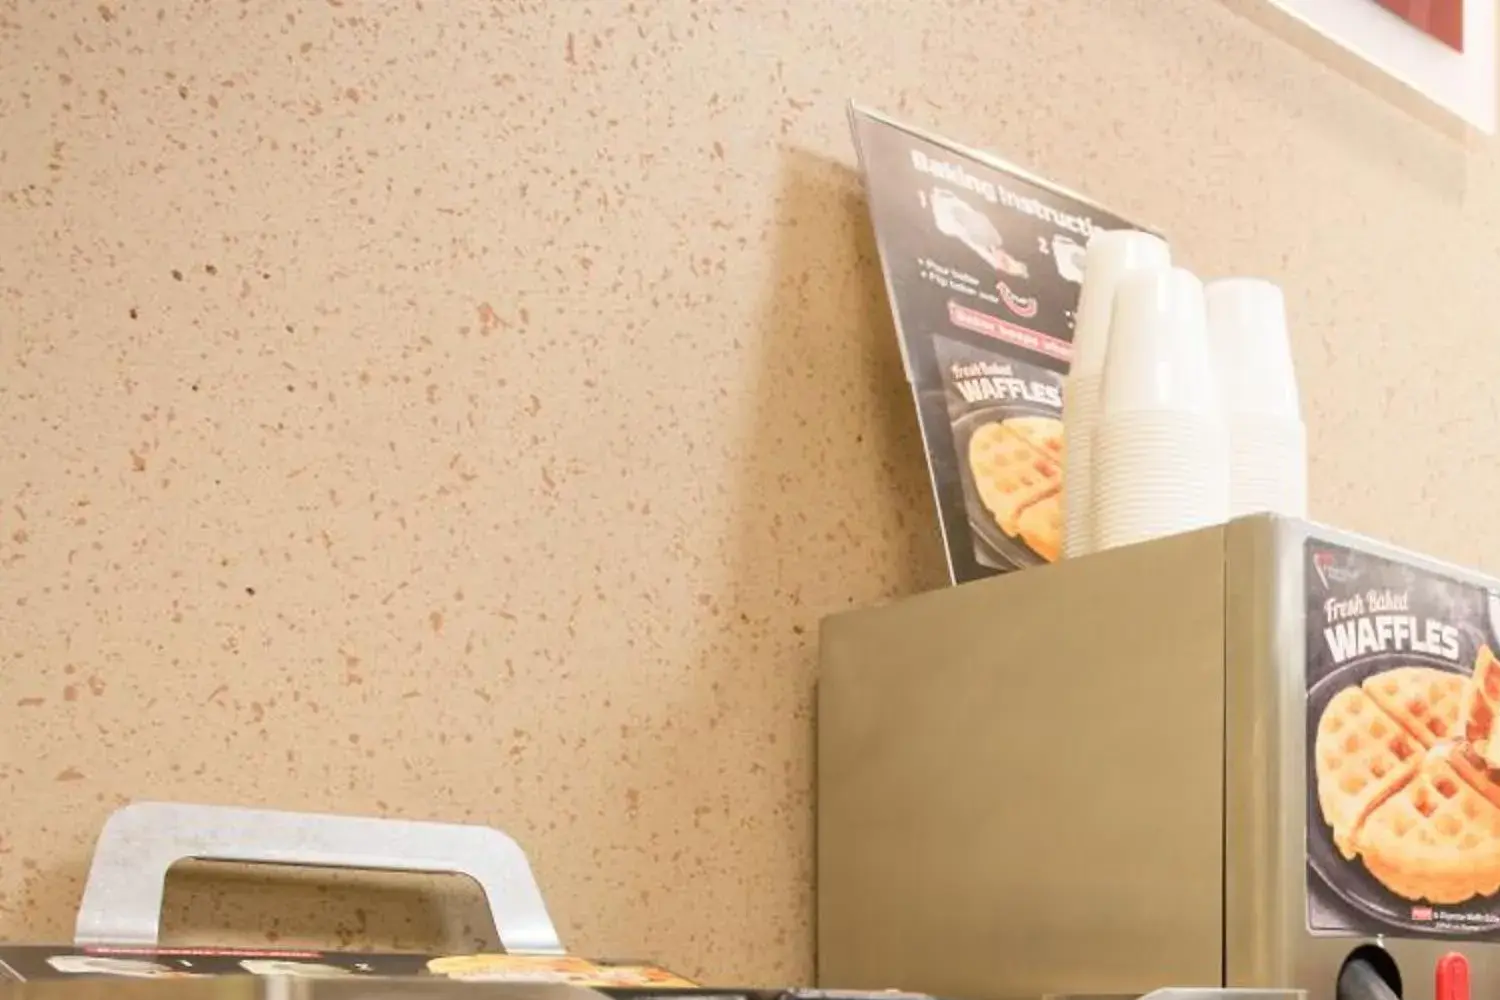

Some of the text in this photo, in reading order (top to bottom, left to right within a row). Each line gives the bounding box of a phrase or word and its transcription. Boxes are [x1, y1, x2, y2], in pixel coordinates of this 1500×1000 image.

[911, 149, 998, 203] Baking
[952, 375, 1062, 408] WAFFLES
[1323, 588, 1409, 622] Fresh Baked
[1323, 615, 1461, 664] WAFFLES
